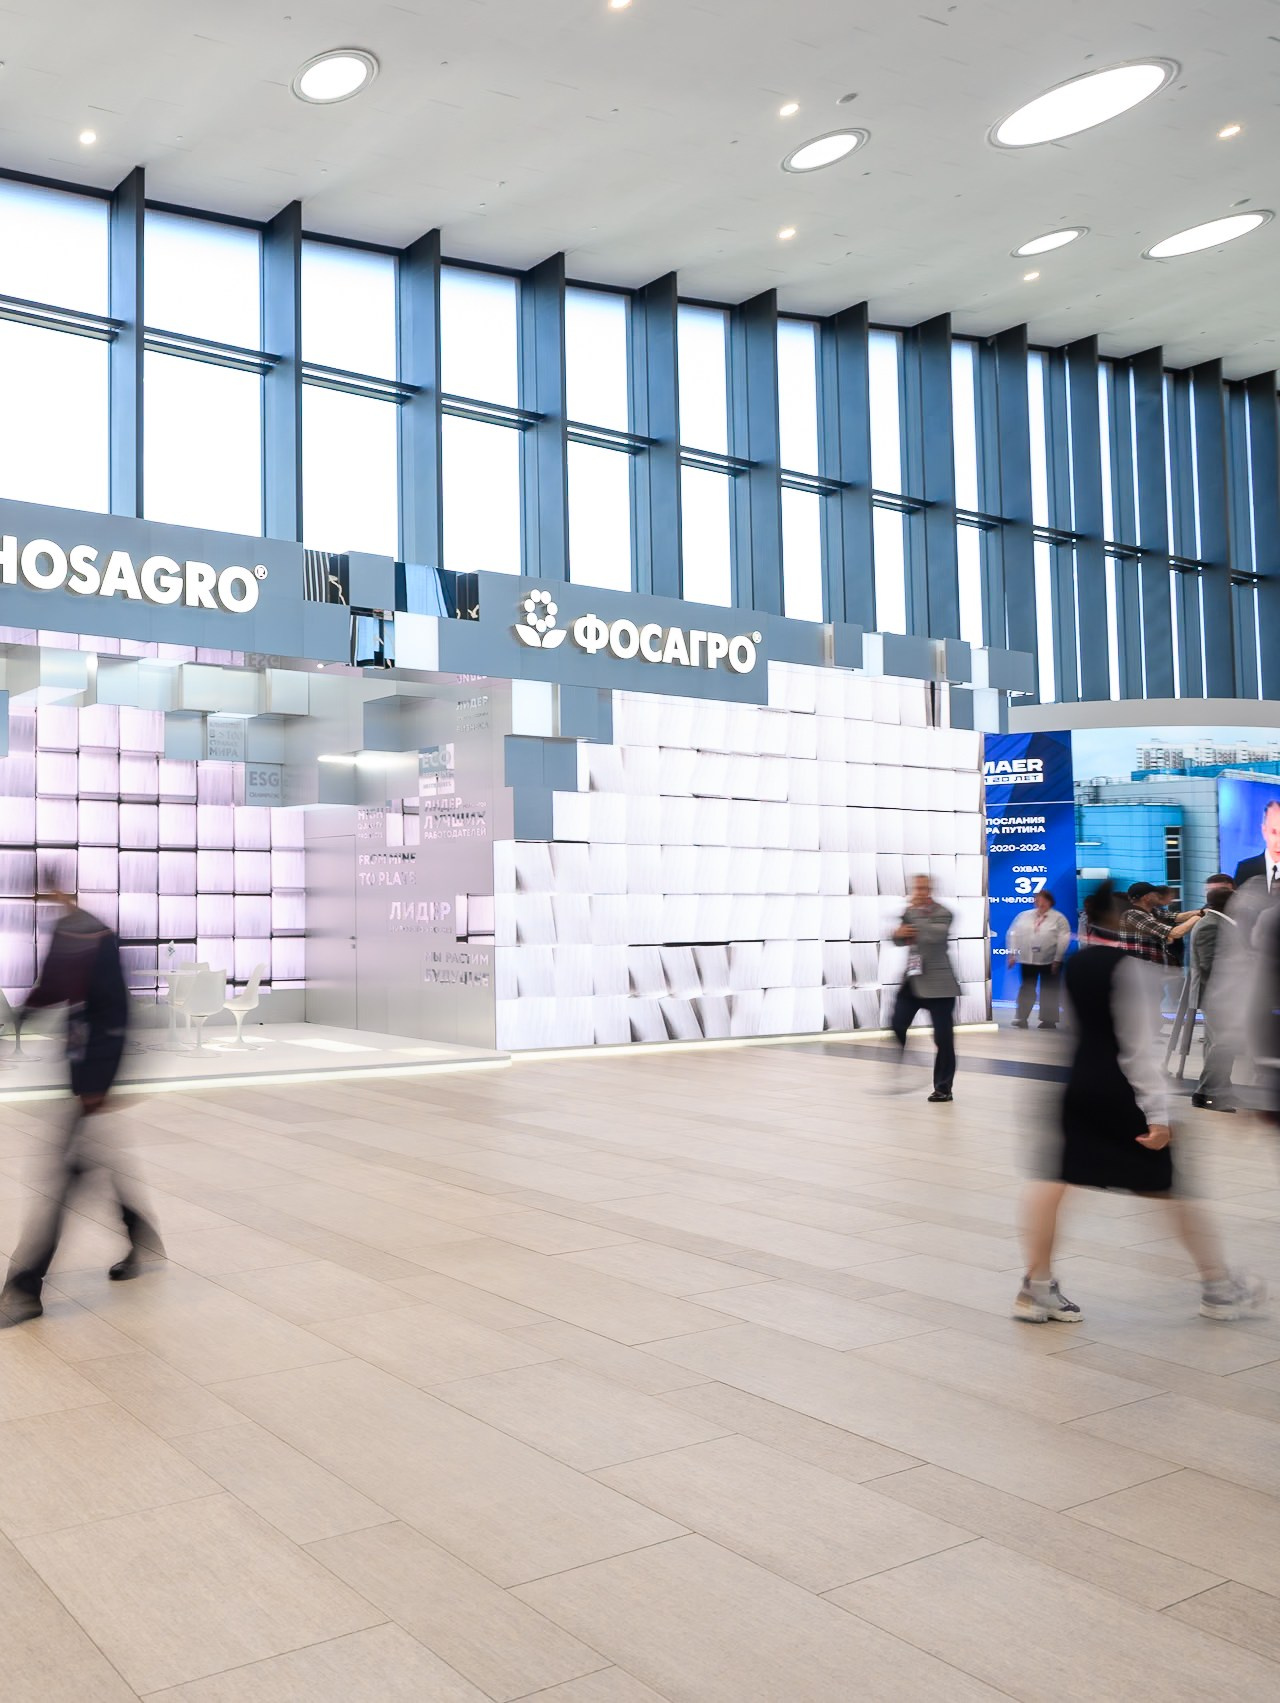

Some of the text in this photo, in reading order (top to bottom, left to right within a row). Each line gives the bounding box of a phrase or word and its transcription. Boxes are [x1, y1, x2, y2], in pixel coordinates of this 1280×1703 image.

[209, 747, 239, 758] МИРА
[248, 771, 280, 787] ESG
[986, 816, 1046, 826] ПОСЛАНИЯ
[424, 827, 487, 839] РАБОТОДАТЕЛЕЙ
[1001, 826, 1046, 834] ПУТИНА
[990, 843, 1046, 853] 2020-2024
[358, 852, 417, 865] FROM MINE
[358, 872, 376, 886] TO
[1014, 876, 1048, 894] 37
[389, 901, 451, 924] ЛИДЕР
[445, 952, 489, 965] РАСТИМ
